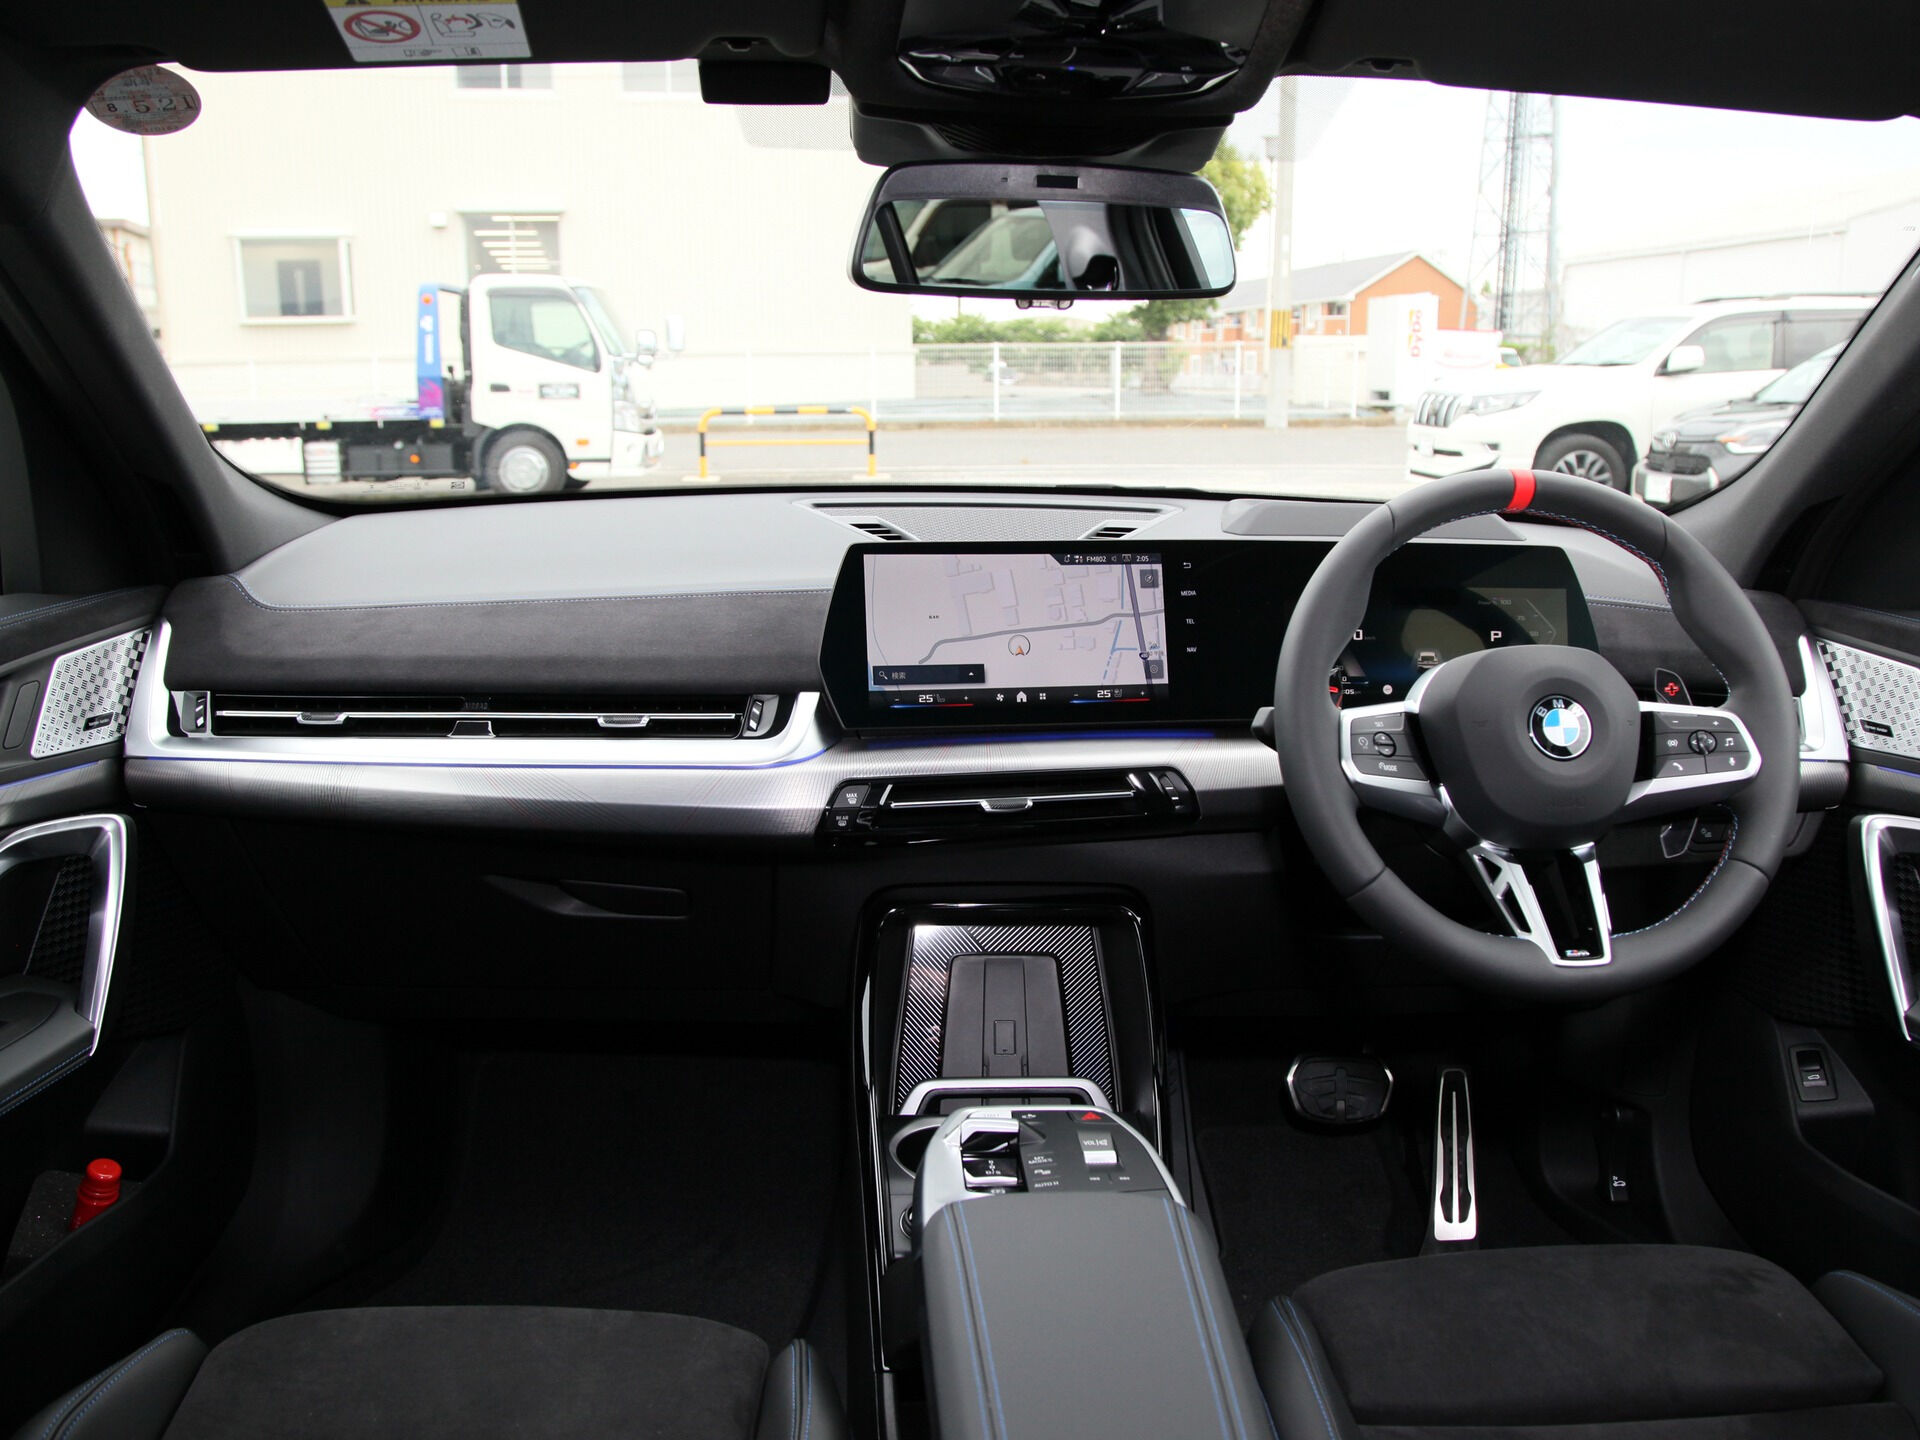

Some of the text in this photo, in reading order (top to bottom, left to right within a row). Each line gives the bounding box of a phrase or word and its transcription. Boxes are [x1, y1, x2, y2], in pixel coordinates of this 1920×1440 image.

[1086, 555, 1107, 563] FM802
[1490, 630, 1502, 642] P
[1536, 699, 1585, 718] BMW
